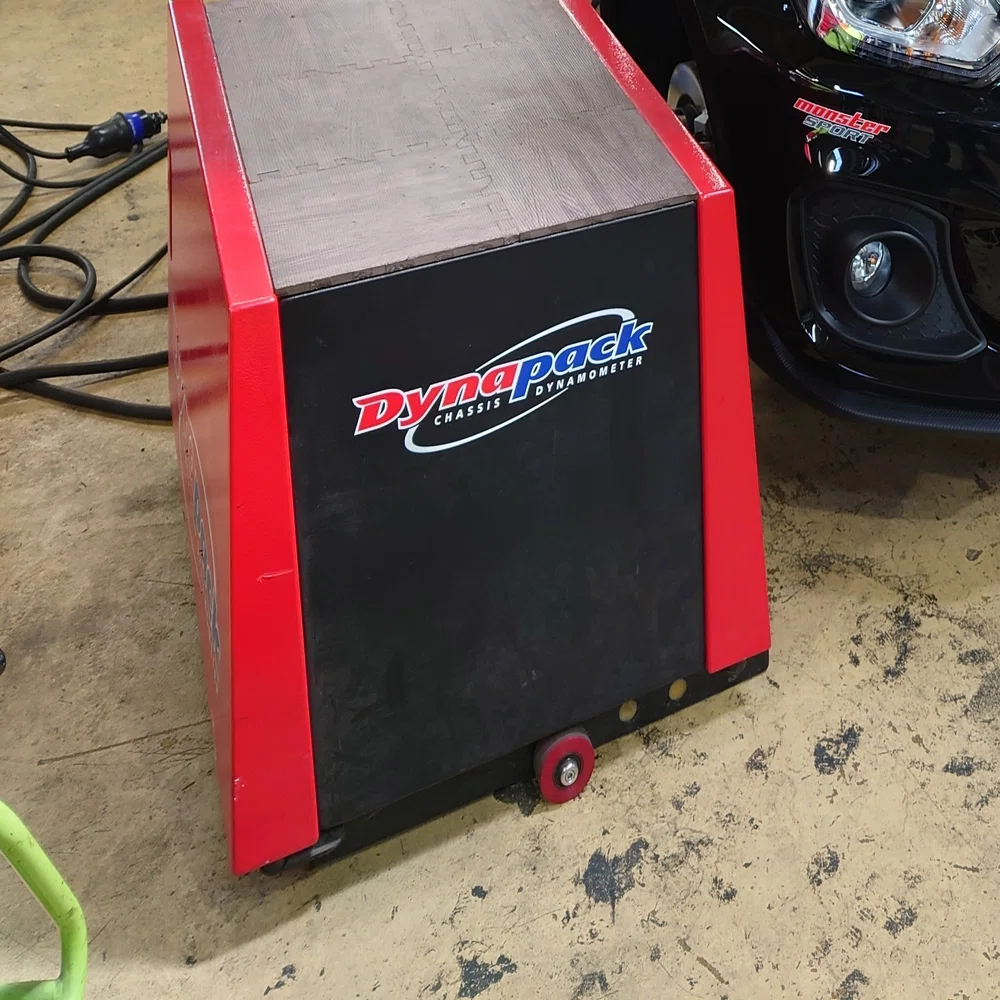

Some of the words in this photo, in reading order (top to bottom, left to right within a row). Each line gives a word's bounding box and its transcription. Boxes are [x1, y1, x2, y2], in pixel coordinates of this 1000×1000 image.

[793, 98, 891, 135] monster
[803, 115, 875, 144] SPORT
[352, 318, 654, 436] Dynapack
[434, 397, 501, 426] CHASSIS
[535, 355, 643, 396] DYNAMOMETER
